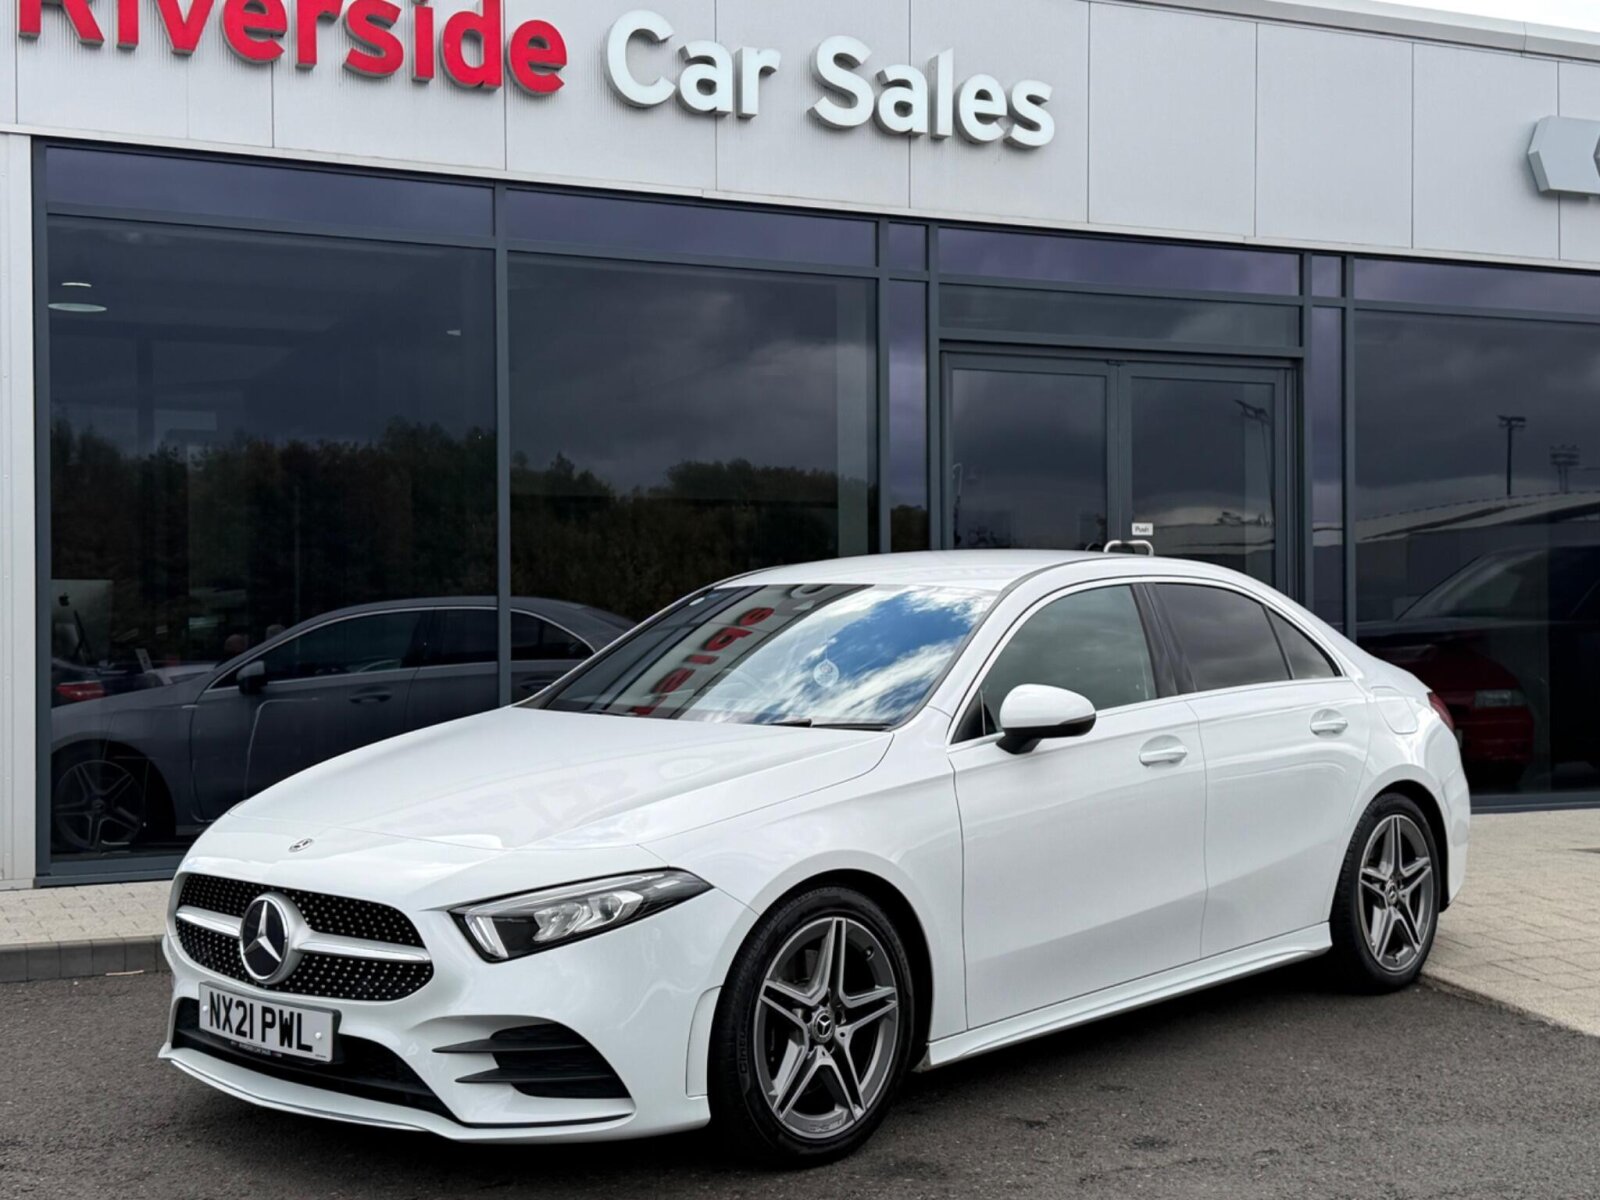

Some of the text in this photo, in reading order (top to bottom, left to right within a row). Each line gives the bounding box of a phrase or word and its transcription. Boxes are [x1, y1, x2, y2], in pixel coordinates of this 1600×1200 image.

[603, 9, 781, 120] Car
[807, 34, 1055, 149] Sales
[209, 991, 313, 1053] NX21 PWL
